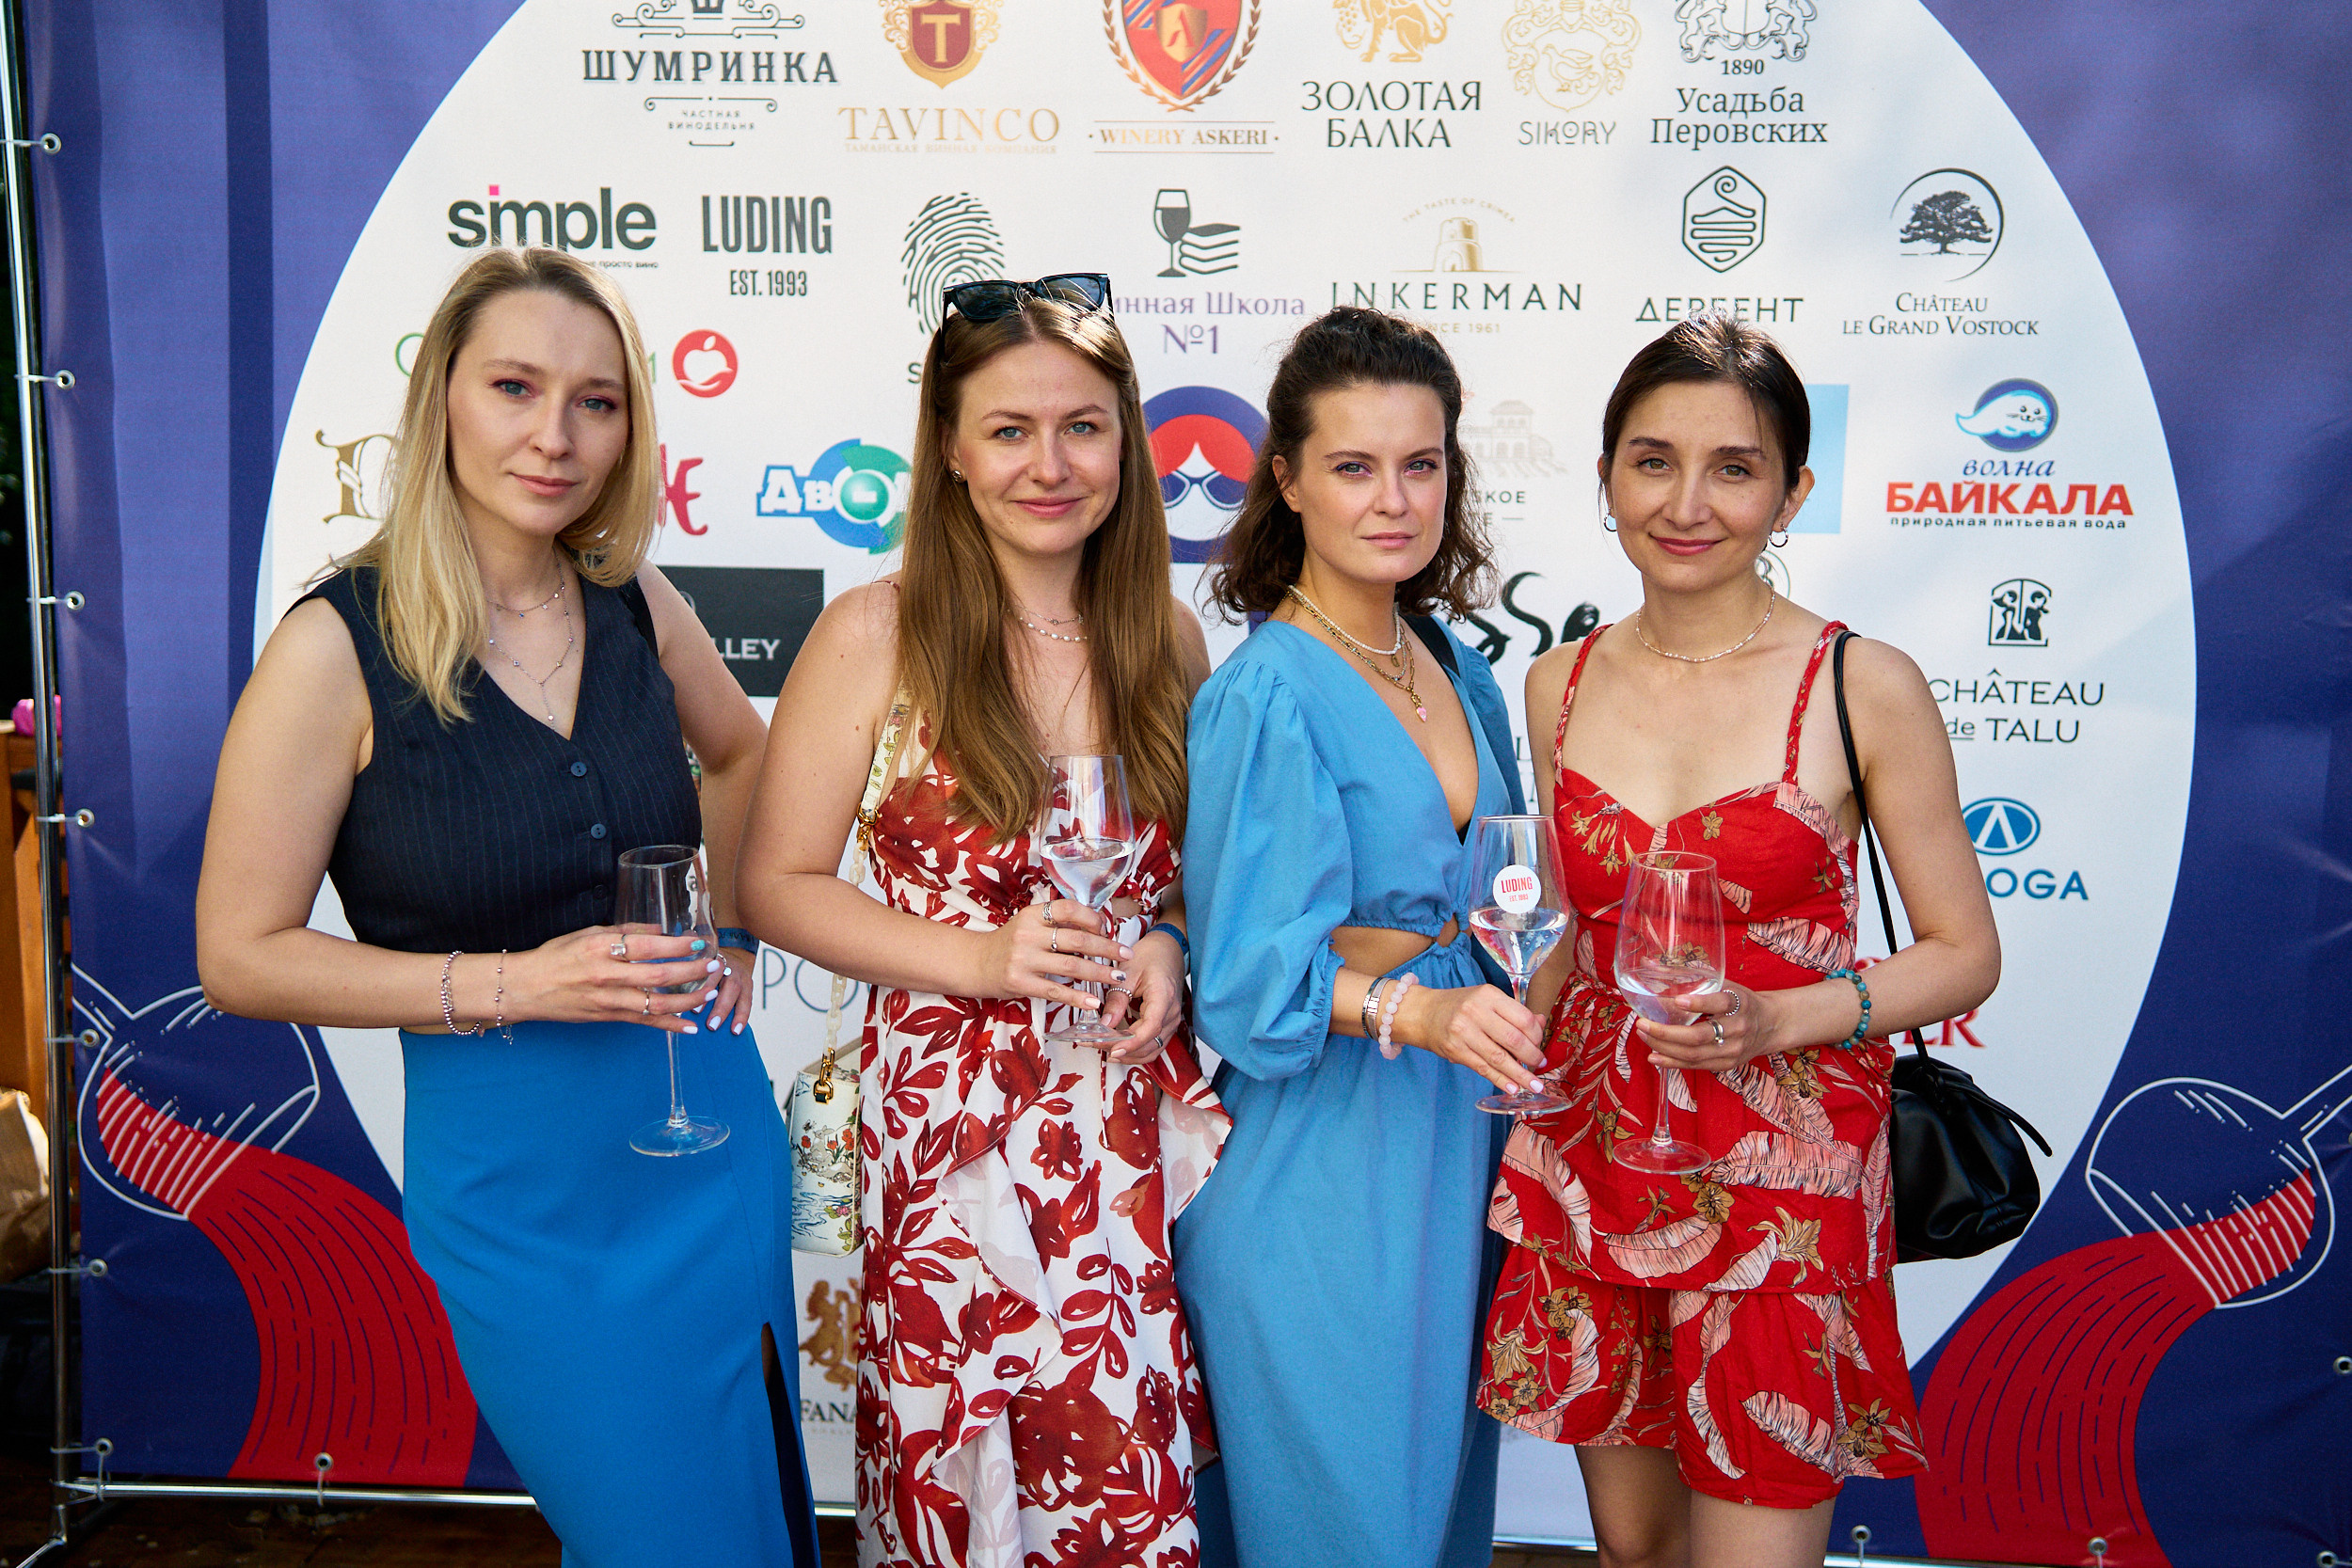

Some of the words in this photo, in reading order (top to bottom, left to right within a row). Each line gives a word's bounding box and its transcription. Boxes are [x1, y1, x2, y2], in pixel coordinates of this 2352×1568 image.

[581, 49, 838, 84] ШУМРИНКА
[1721, 59, 1765, 75] 1890
[1301, 81, 1482, 111] ЗОЛОТАЯ
[1677, 86, 1804, 119] Усадьба
[668, 121, 755, 131] ВИНОДЕЛЬНЯ
[682, 110, 740, 119] ЧАСТНАЯ
[837, 106, 1060, 141] TAVINCO
[1100, 129, 1184, 145] WINERY
[1192, 129, 1267, 145] ASKERI
[1327, 119, 1452, 148] БАЛКА
[1650, 119, 1828, 151] Перовских
[447, 184, 658, 252] simple
[701, 196, 833, 254] LUDING
[730, 270, 763, 296] EST.
[767, 270, 808, 296] 1993
[1330, 282, 1581, 310] INKERMAN
[1114, 296, 1195, 315] инная
[1207, 292, 1305, 315] Школа
[1469, 324, 1501, 333] 1961
[1962, 459, 2055, 477] волна
[1886, 480, 2135, 516] БАЙКАЛА
[1890, 517, 1987, 528] природная
[1993, 518, 2077, 529] питьевая
[2083, 519, 2127, 530] вода
[710, 637, 781, 659] LEY
[1929, 668, 2105, 705] CHÂTEAU
[1947, 717, 1976, 736] de
[1984, 718, 2080, 744] TALU
[1502, 877, 1533, 893] LUDING
[1985, 867, 2090, 900] OGA
